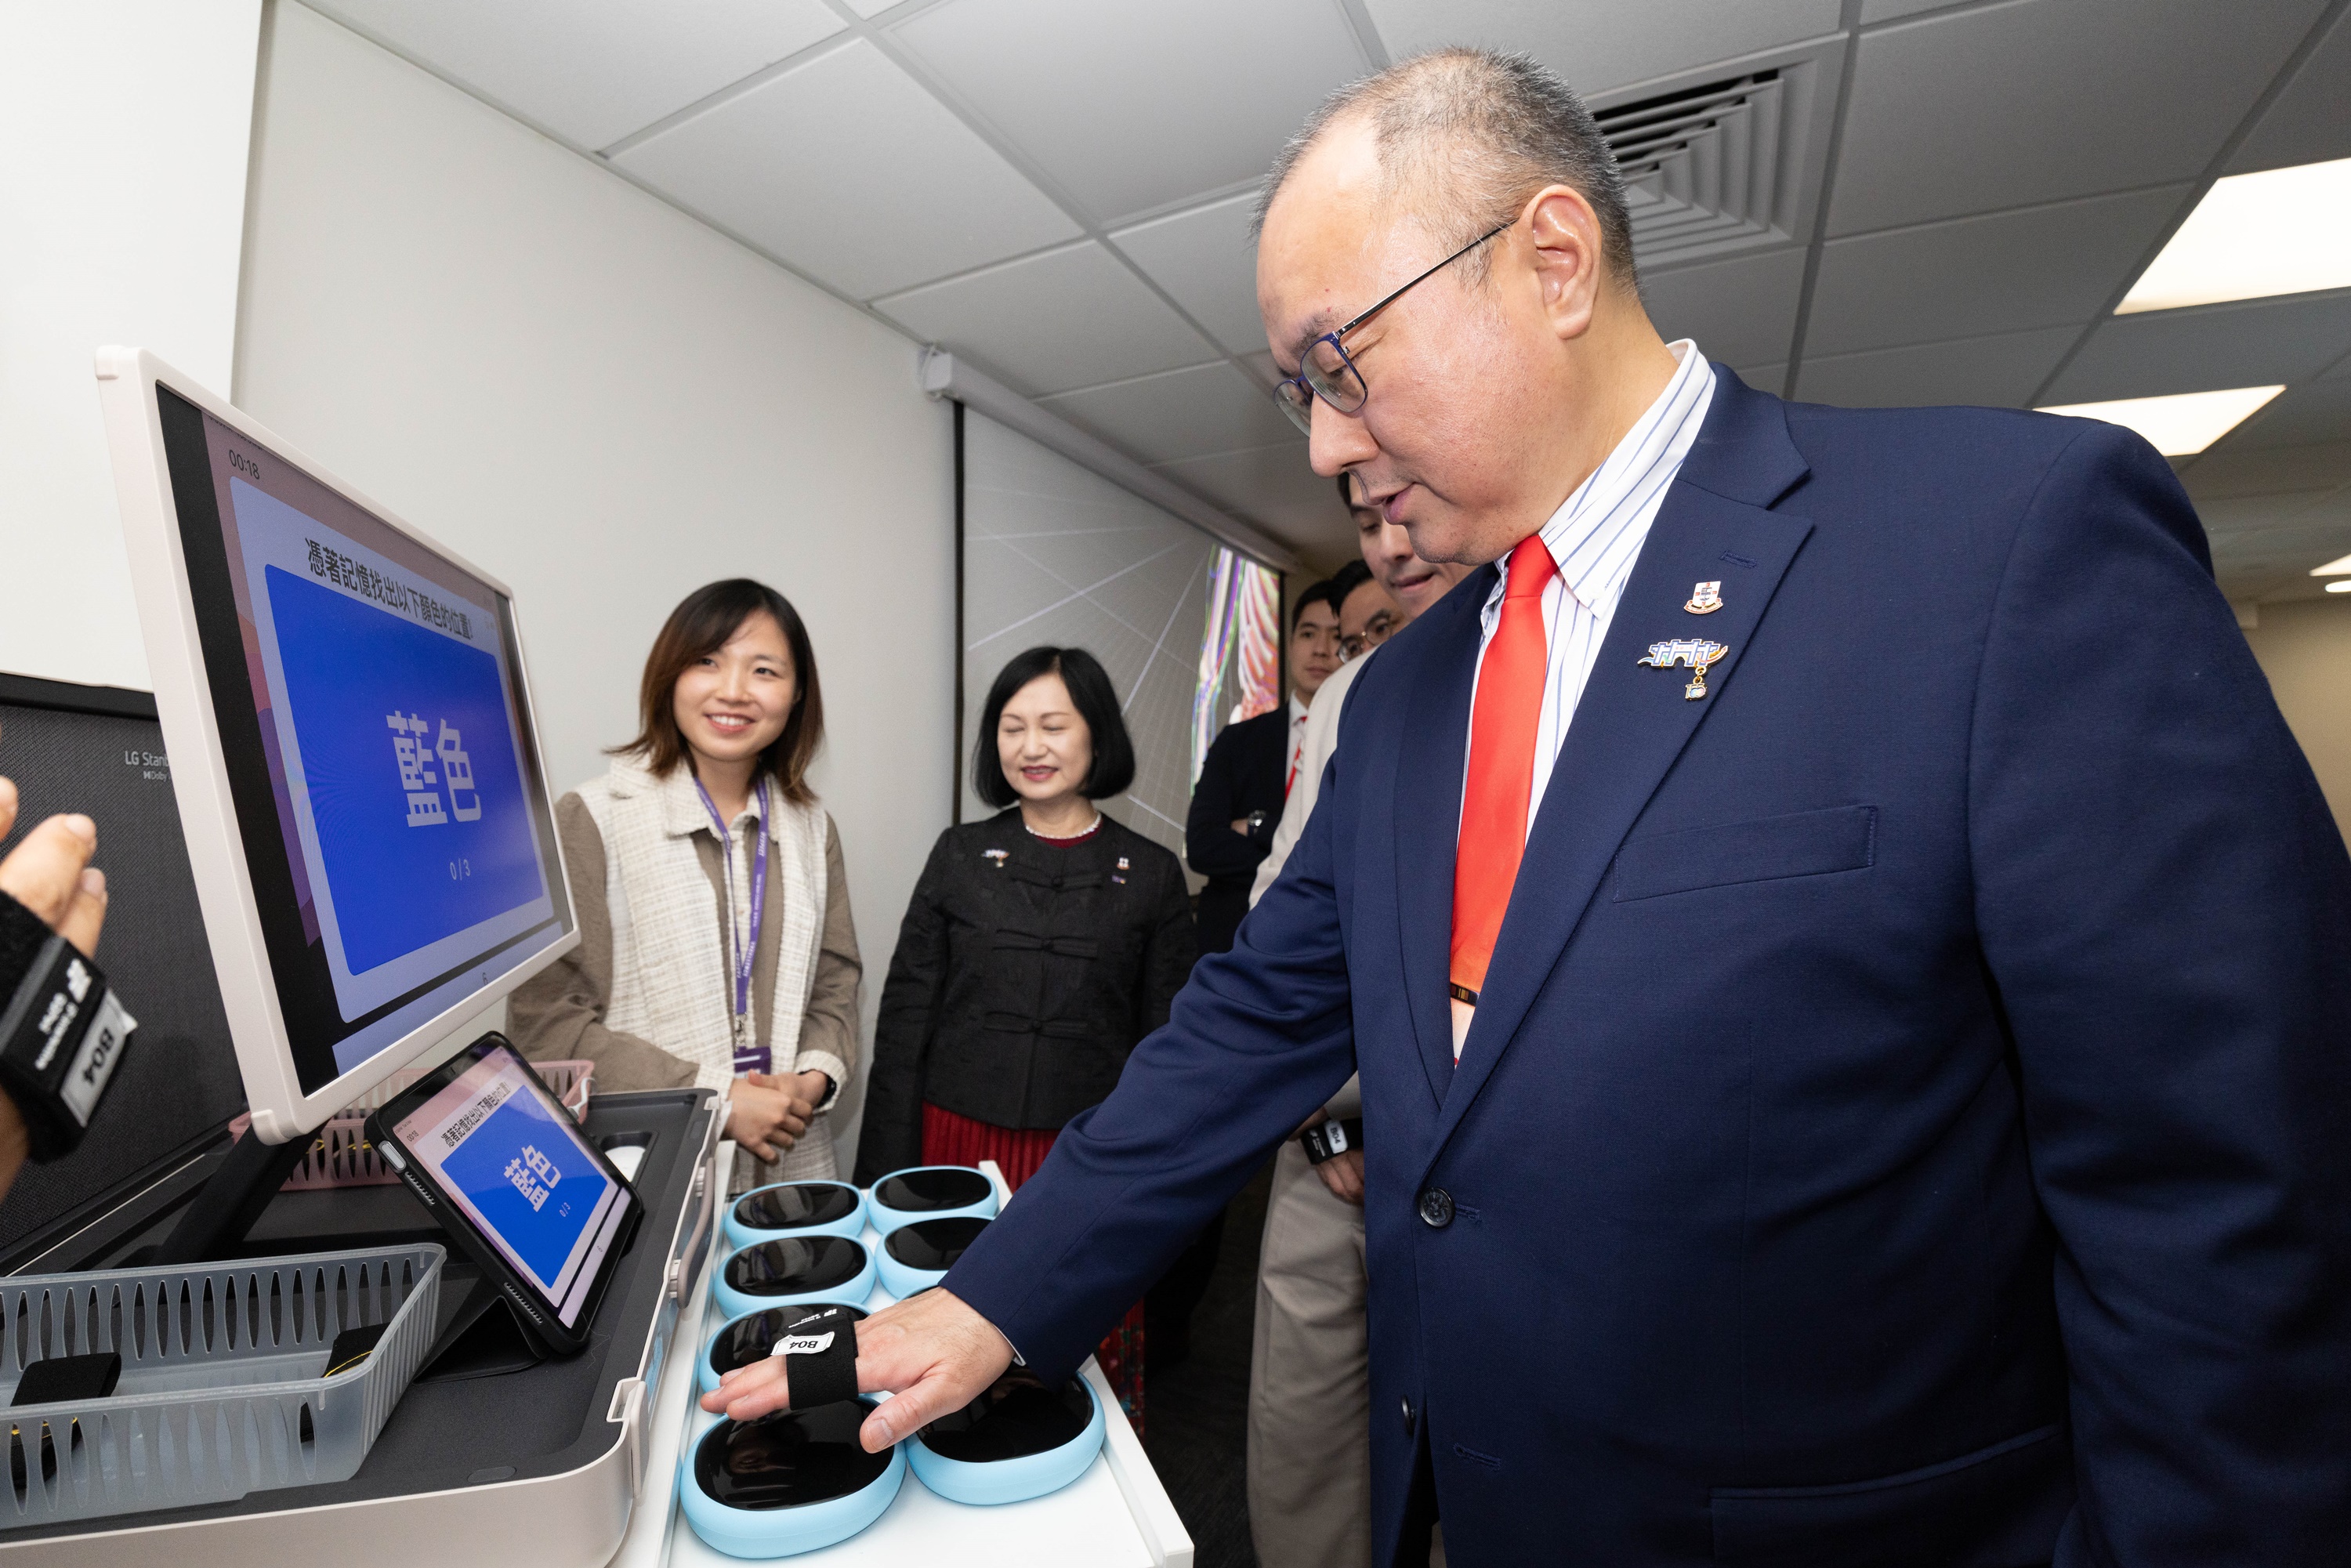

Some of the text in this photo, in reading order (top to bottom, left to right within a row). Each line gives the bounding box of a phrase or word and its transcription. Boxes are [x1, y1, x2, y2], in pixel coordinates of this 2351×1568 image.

[229, 449, 260, 480] 00:18
[125, 750, 139, 766] LG
[386, 710, 482, 827] 藍色
[82, 1027, 114, 1086] B04
[406, 1130, 419, 1142] 00:18
[1330, 1128, 1341, 1144] B04
[503, 1145, 562, 1212] 藍色
[789, 1341, 818, 1349] B04
